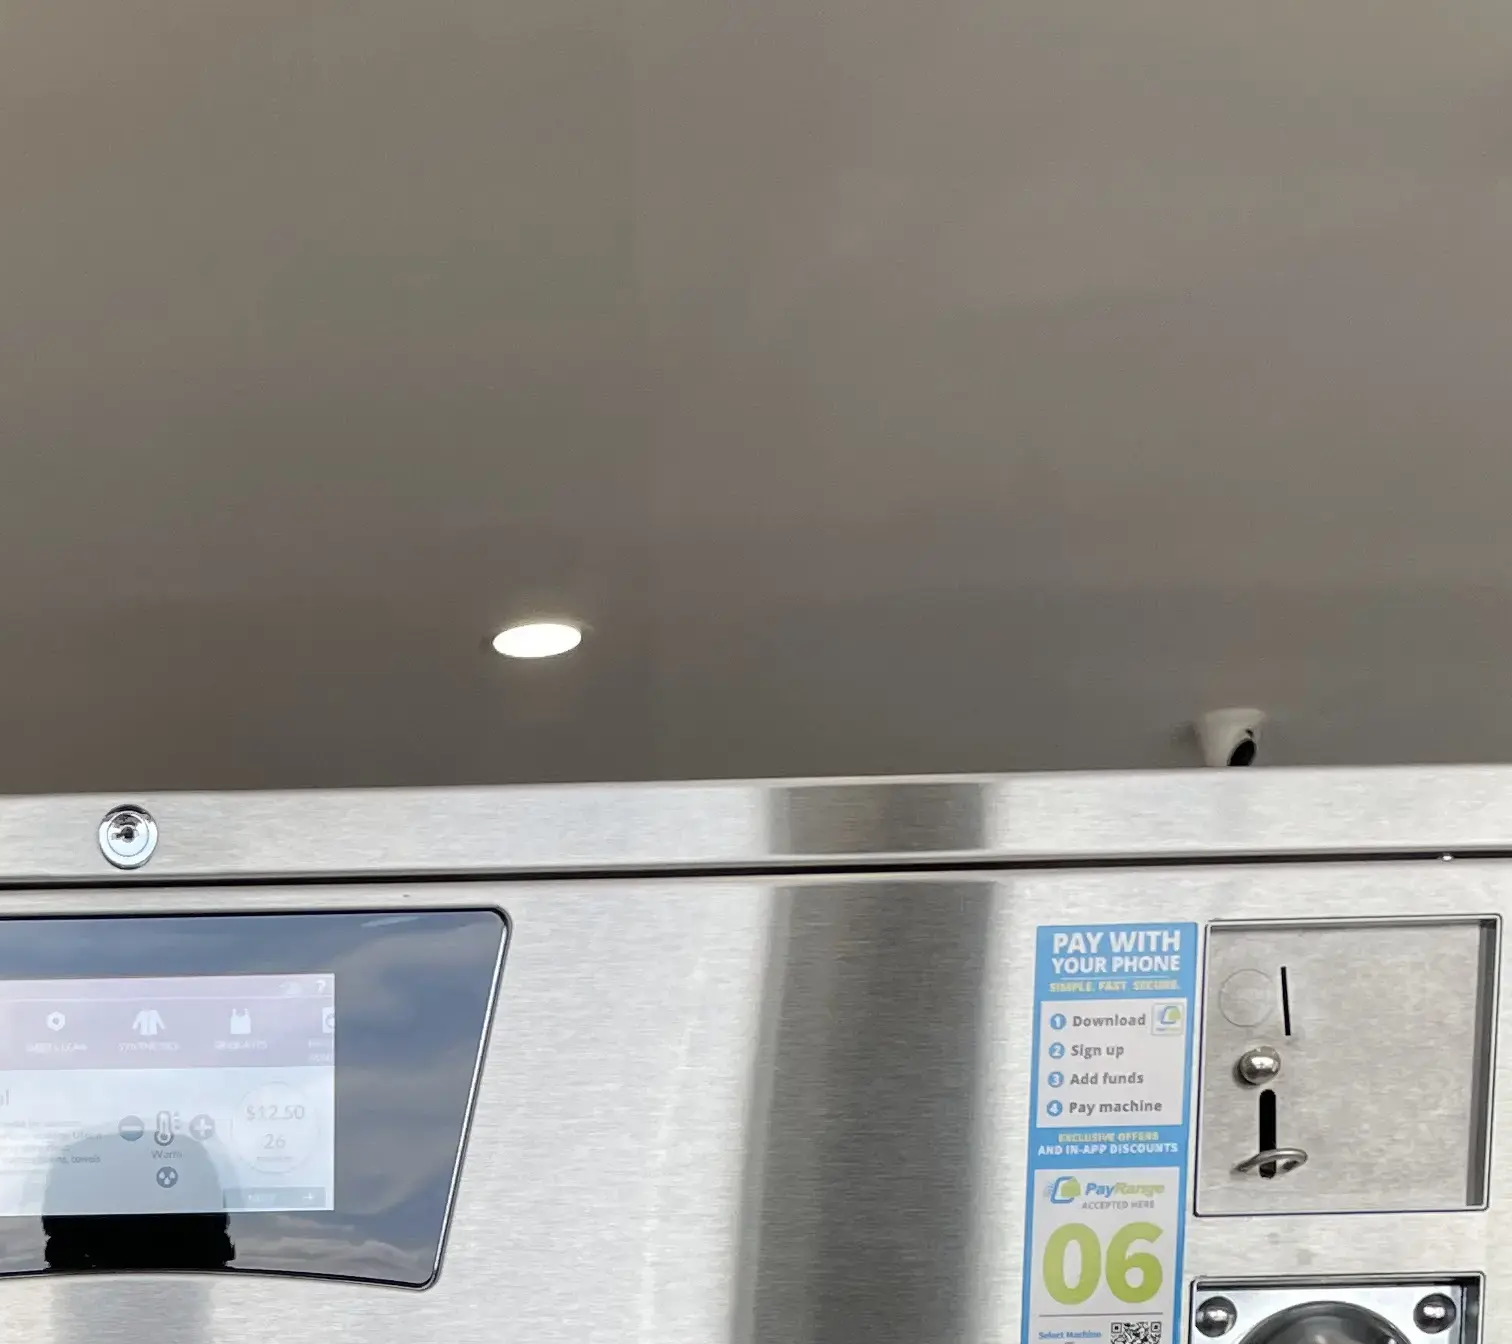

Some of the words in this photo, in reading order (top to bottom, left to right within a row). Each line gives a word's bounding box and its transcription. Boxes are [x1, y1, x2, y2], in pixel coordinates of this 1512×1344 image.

[1053, 932, 1104, 954] PAY
[1109, 930, 1181, 953] WITH
[1051, 957, 1107, 974] YOUR
[1111, 955, 1181, 973] PHONE
[1072, 1013, 1147, 1027] Download
[1070, 1044, 1102, 1060] Sign
[1106, 1046, 1125, 1059] up
[1070, 1073, 1099, 1085] Add
[1103, 1072, 1144, 1085] funds
[1069, 1102, 1096, 1116] Pay
[1099, 1100, 1163, 1113] machine
[1109, 1142, 1178, 1155] DISCOUNTS
[1084, 1181, 1165, 1199] PayRange
[1082, 1200, 1128, 1210] ACCEPTED
[1043, 1221, 1164, 1306] 06
